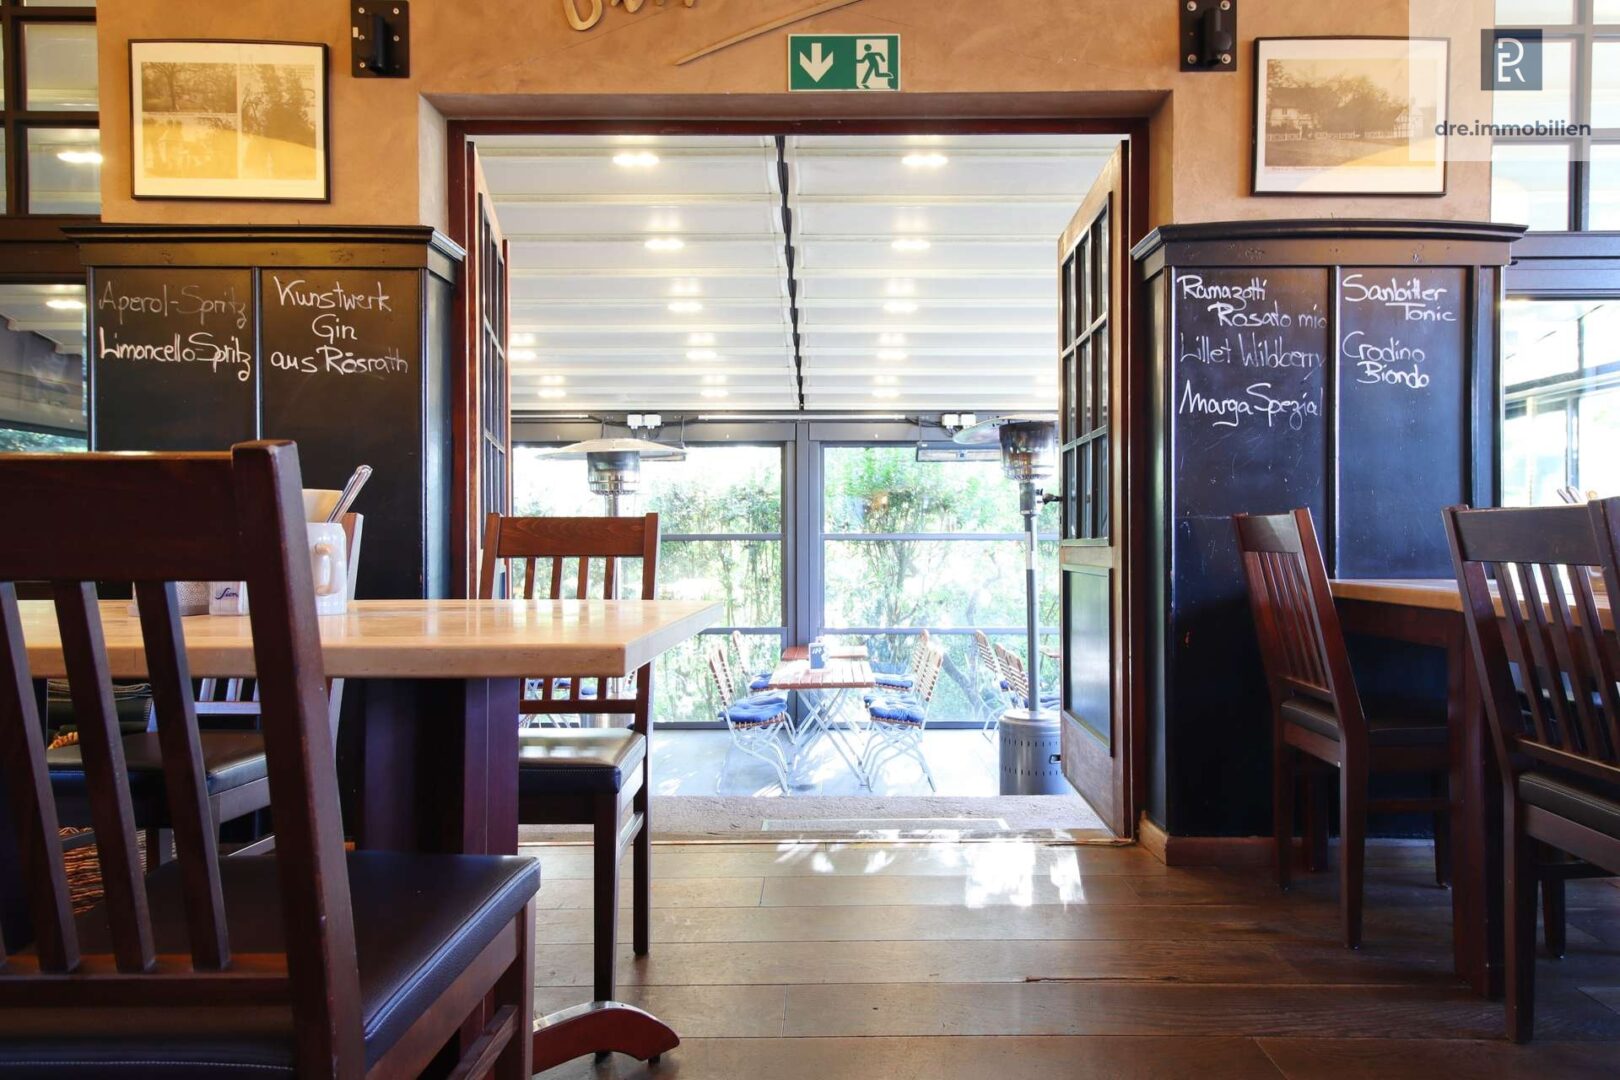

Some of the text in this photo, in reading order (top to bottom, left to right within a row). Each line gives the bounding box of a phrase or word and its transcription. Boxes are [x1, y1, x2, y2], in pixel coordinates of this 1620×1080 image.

[273, 275, 392, 312] Kunstwerk
[1176, 274, 1267, 312] Ramazotti
[1342, 274, 1448, 301] Sanbitter
[1207, 300, 1328, 329] Rosato mio
[1384, 302, 1457, 321] Tonic
[311, 313, 358, 345] Gin
[270, 345, 408, 375] aus Rösrath
[1180, 332, 1232, 364] Lillet
[1342, 330, 1426, 362] Crodino
[1356, 361, 1430, 389] Biondo
[1179, 379, 1324, 431] Marga Spezial
